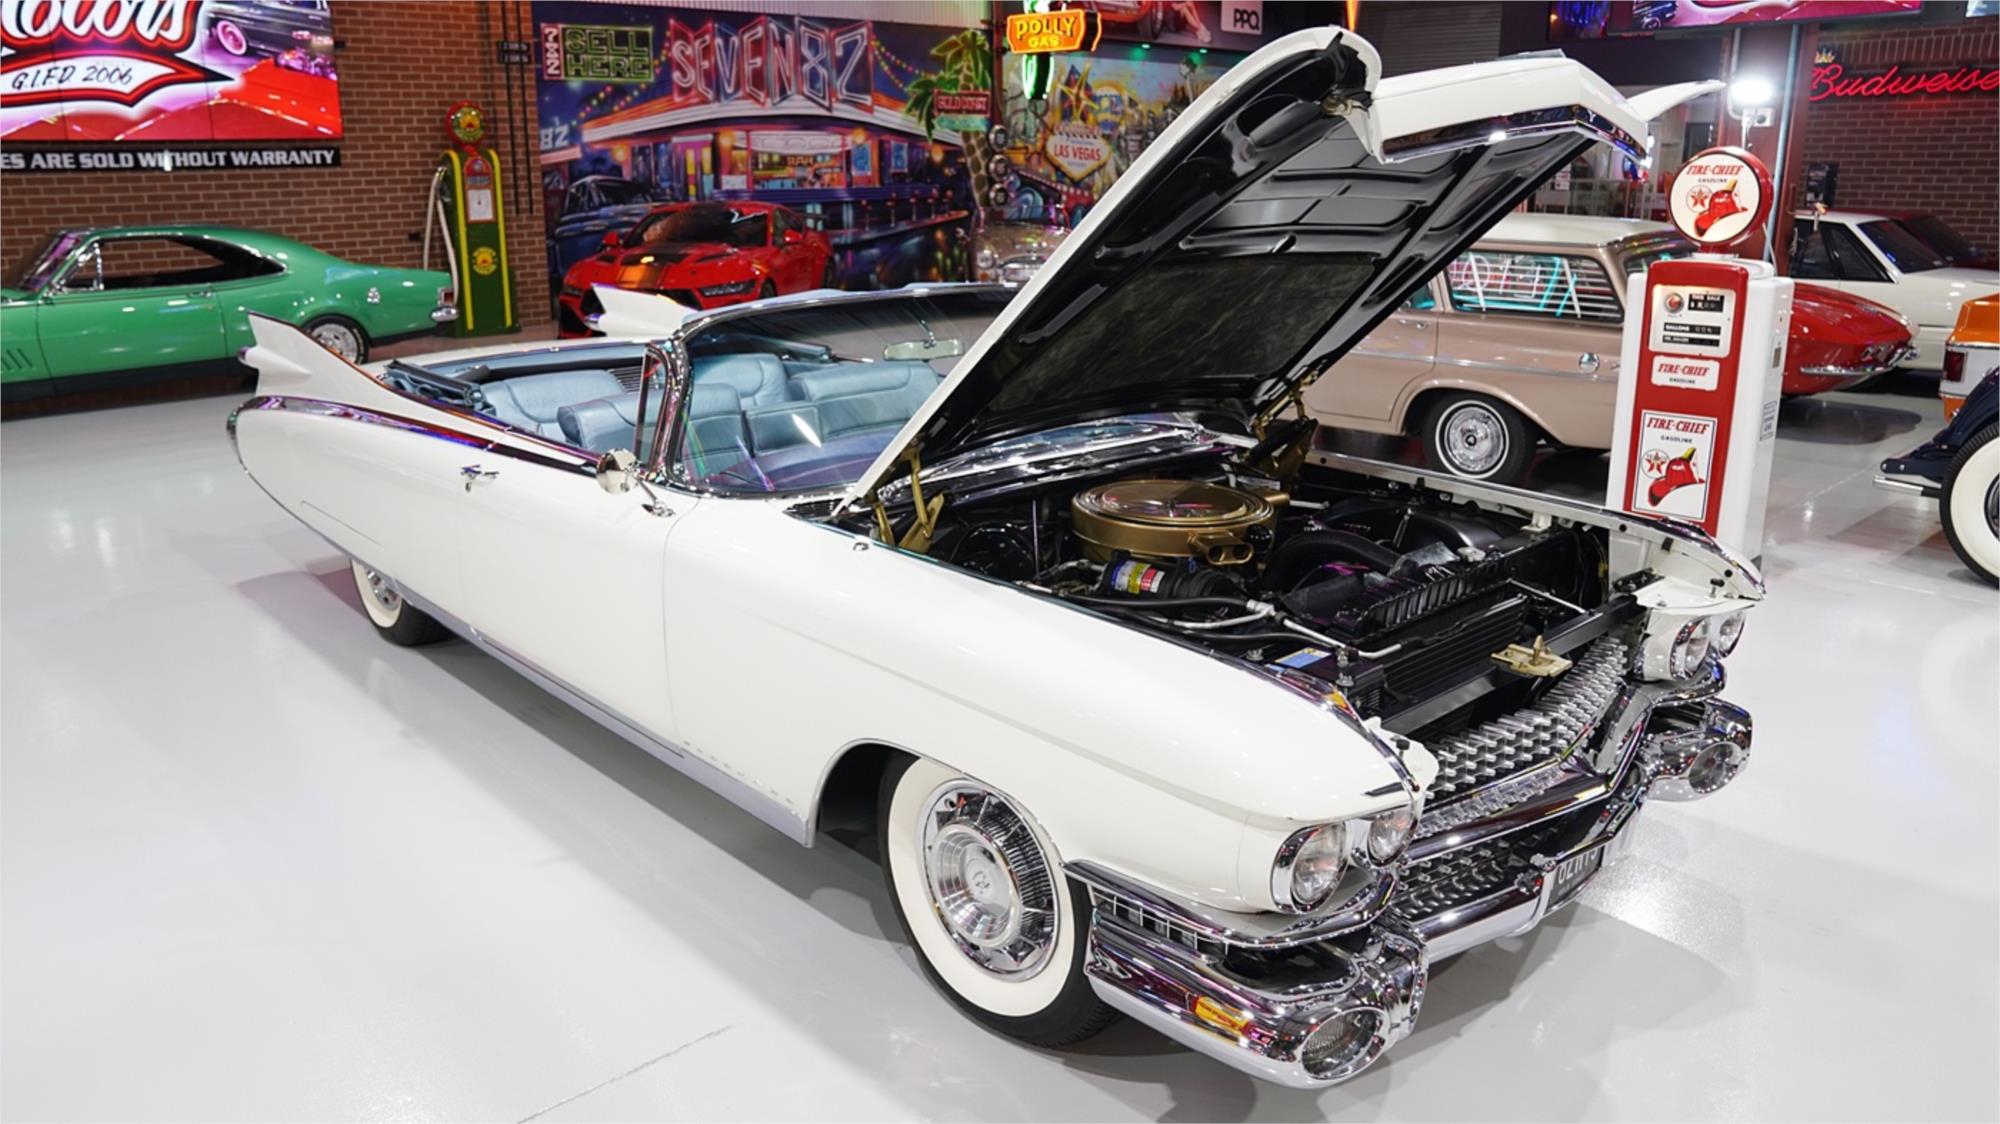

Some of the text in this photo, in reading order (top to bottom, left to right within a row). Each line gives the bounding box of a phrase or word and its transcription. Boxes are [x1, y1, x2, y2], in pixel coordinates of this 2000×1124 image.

[1015, 17, 1076, 40] POLLY
[1233, 7, 1260, 31] PPQ
[564, 28, 650, 56] SELL
[1027, 35, 1060, 48] GAS
[81, 64, 133, 86] 2006
[565, 53, 651, 78] HERE
[30, 153, 77, 169] ARE
[79, 152, 134, 169] SOLD
[137, 151, 227, 168] WITHOUT
[230, 149, 335, 166] WARRANTY
[1053, 143, 1070, 158] LAS
[1072, 146, 1102, 161] VEGAS
[1686, 164, 1745, 176] FIRE-CHIEF
[1657, 362, 1710, 377] FIRE-CHIEF
[1646, 416, 1710, 435] FIRE-CHIEF
